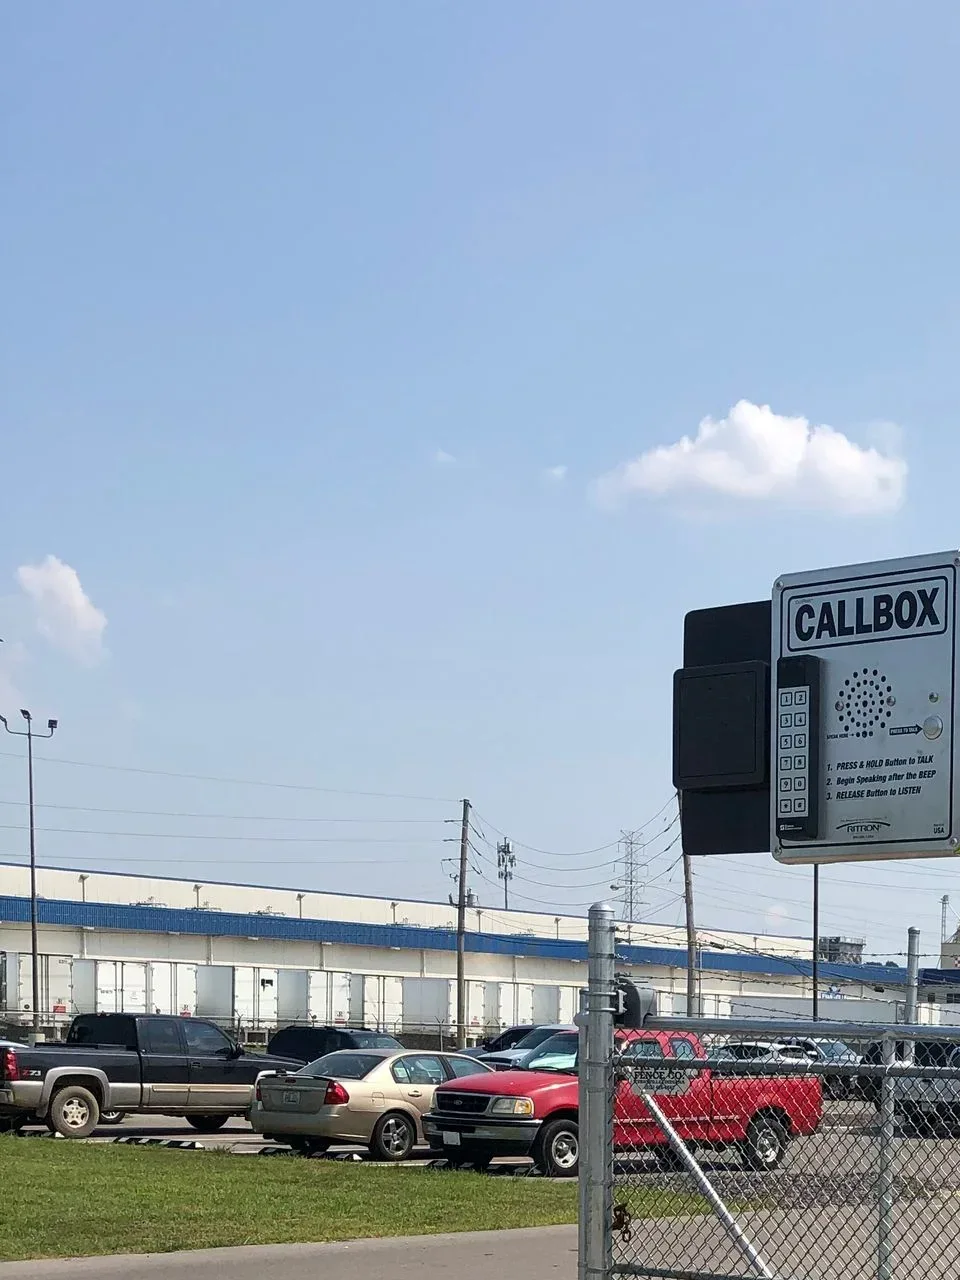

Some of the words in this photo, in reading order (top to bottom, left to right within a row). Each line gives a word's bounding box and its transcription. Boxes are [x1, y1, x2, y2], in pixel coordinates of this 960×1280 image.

[795, 587, 940, 642] CALLBOX
[826, 763, 833, 772] 1.
[836, 761, 858, 771] PRESS
[859, 760, 865, 769] &
[865, 759, 884, 768] HOLD
[885, 758, 907, 767] Button
[908, 757, 916, 765] to
[917, 755, 935, 764] TALK
[826, 778, 833, 786] 2.
[836, 776, 855, 786] Begin
[856, 774, 887, 785] Speaking
[888, 772, 905, 781] after
[905, 771, 917, 780] the
[918, 770, 937, 779] BEEP
[826, 792, 832, 800] 3.
[836, 790, 865, 800] RELEASE
[866, 788, 888, 798] Button
[889, 788, 897, 796] to
[898, 786, 921, 795] LISTEN
[846, 824, 880, 833] RITRON
[634, 1071, 665, 1080] FENCE
[667, 1071, 685, 1080] CO.
